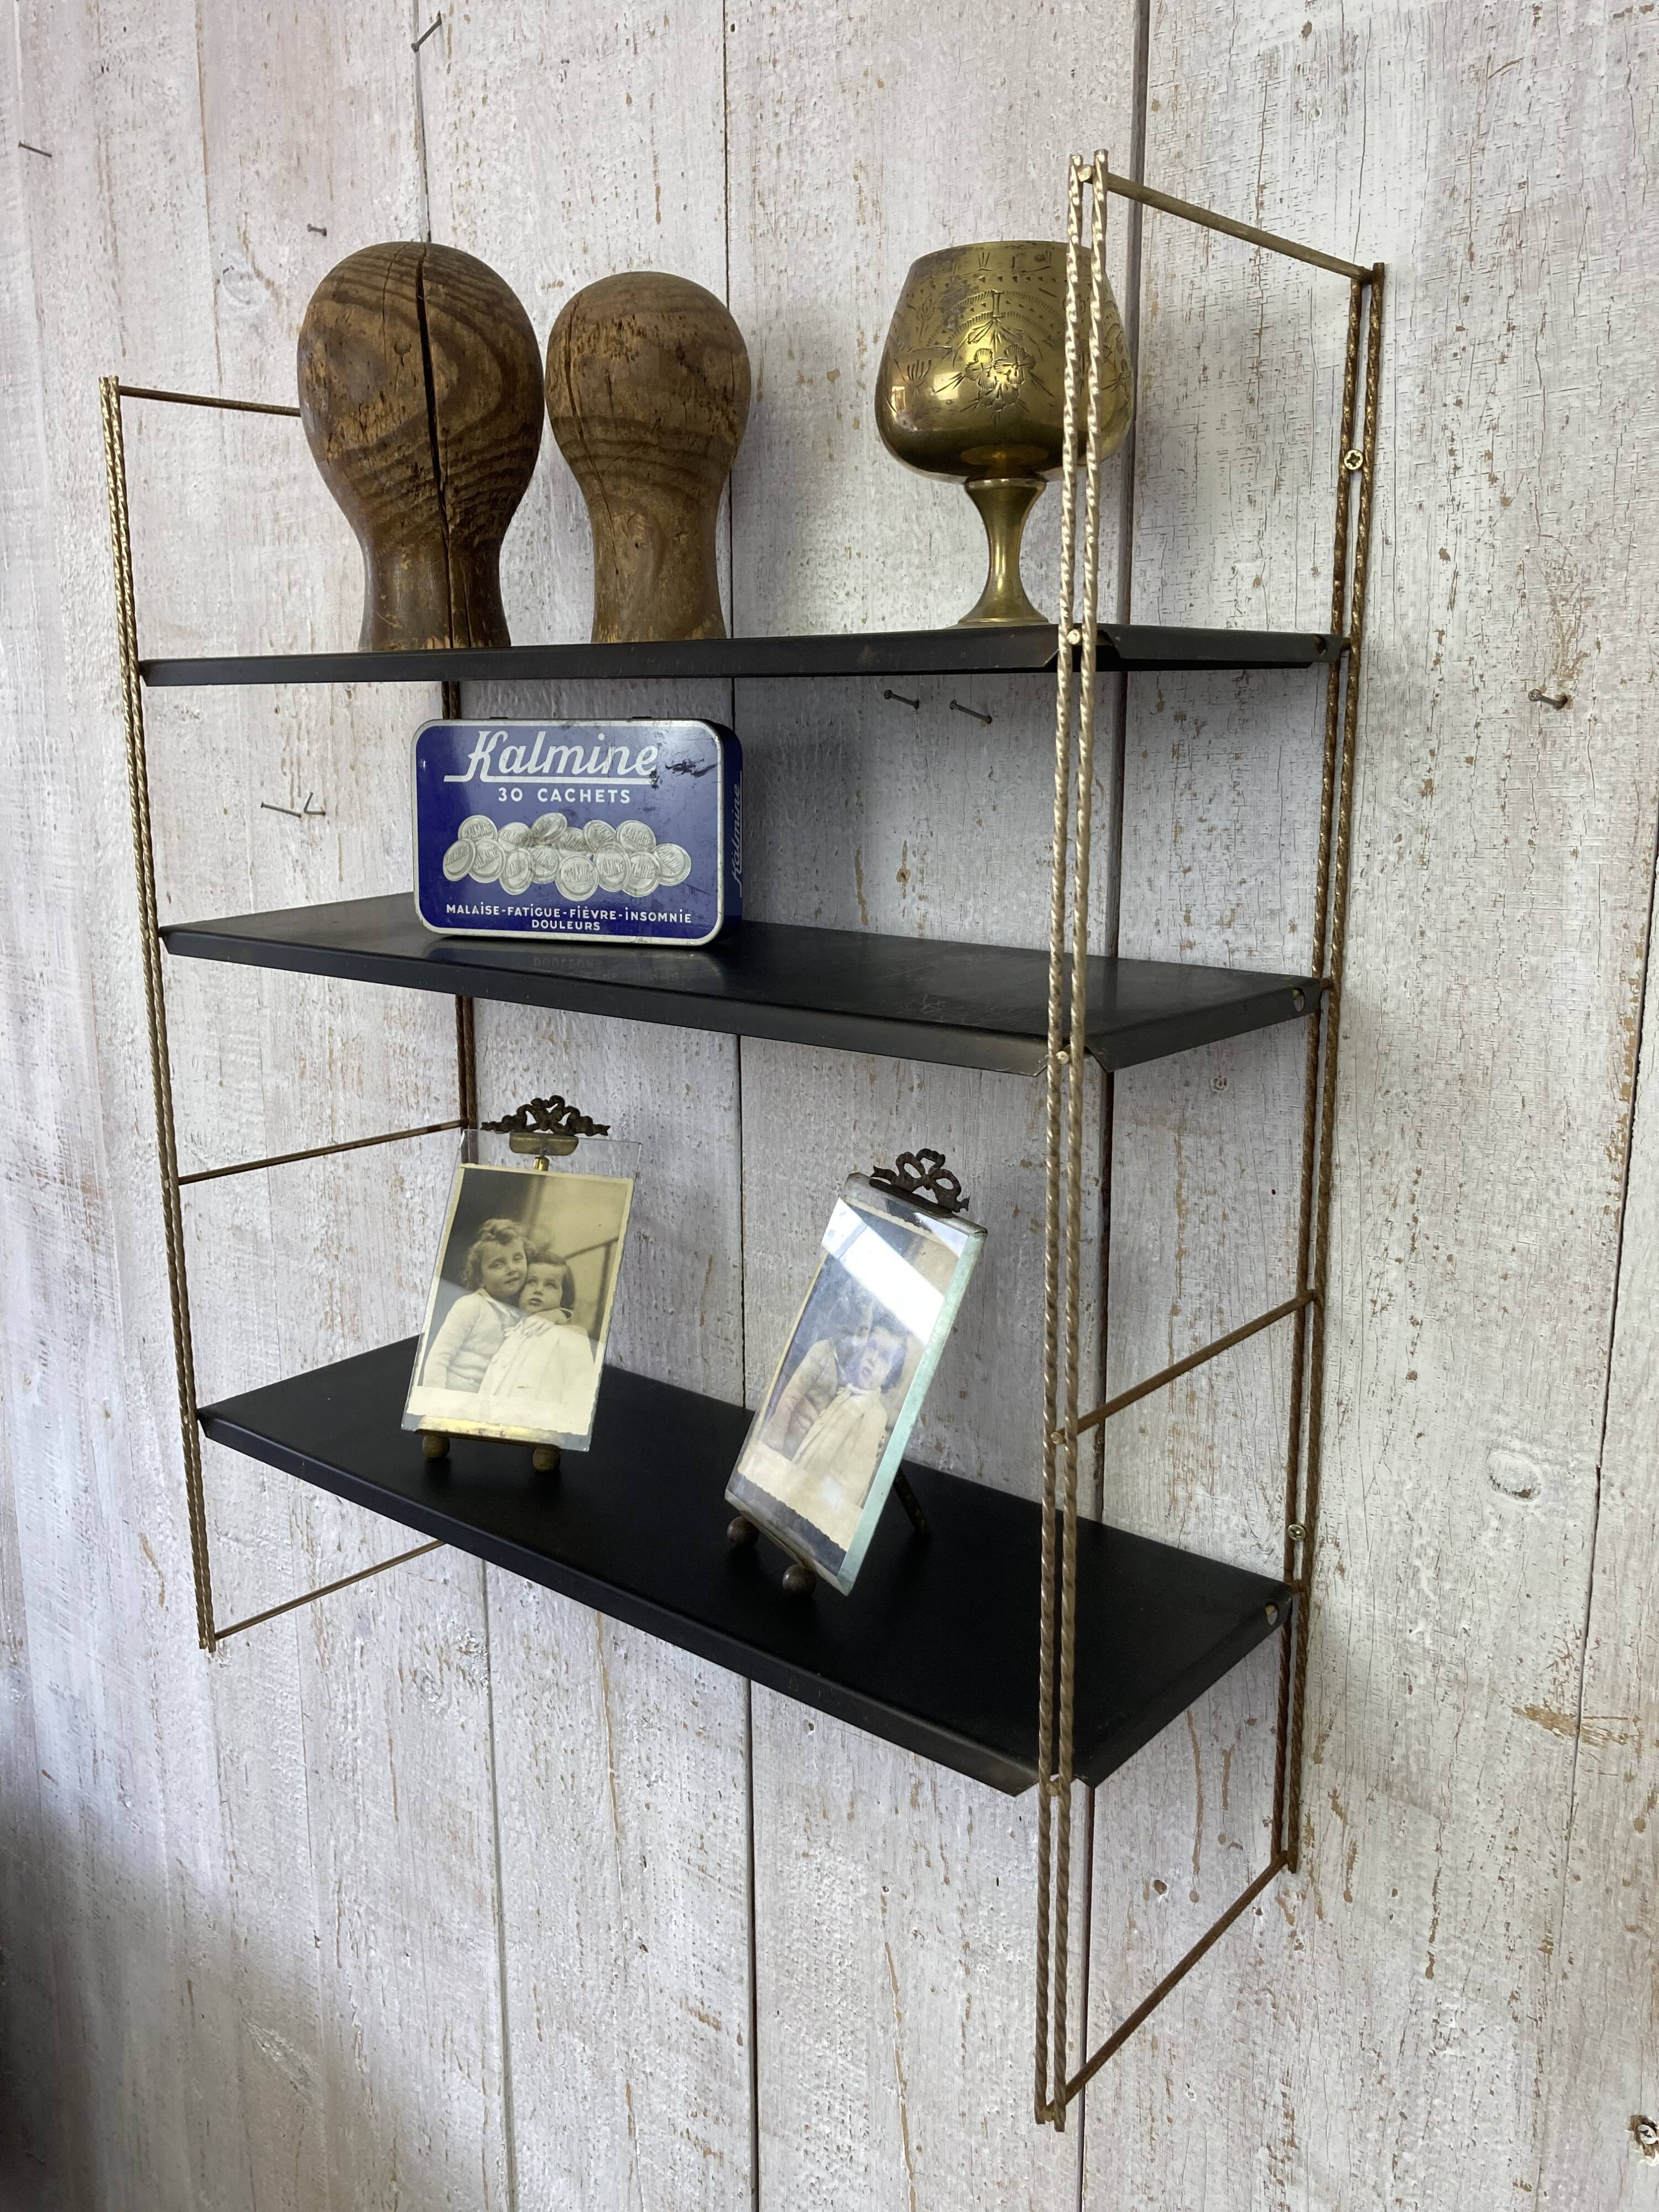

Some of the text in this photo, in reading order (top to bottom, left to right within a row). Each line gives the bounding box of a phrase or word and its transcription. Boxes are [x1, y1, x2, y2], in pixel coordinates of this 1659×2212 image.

[444, 731, 659, 784] Kalmine
[498, 787, 631, 804] 30 CACHETS
[532, 919, 601, 931] DOULEURS
